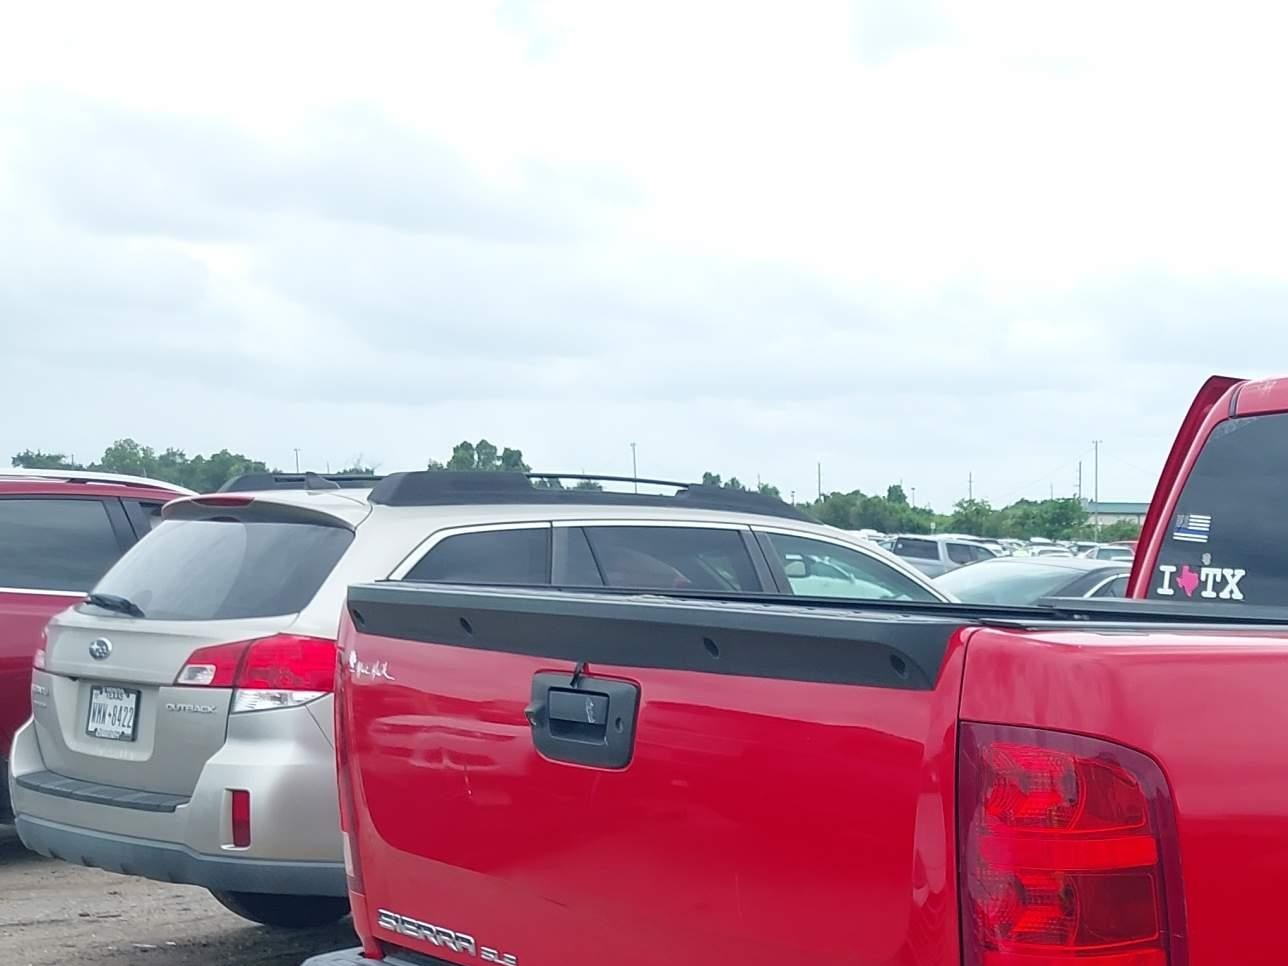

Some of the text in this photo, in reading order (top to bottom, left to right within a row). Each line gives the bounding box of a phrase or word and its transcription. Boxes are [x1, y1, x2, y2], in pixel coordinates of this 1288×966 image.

[1156, 565, 1246, 600] I TX
[378, 908, 477, 957] SIERRA
